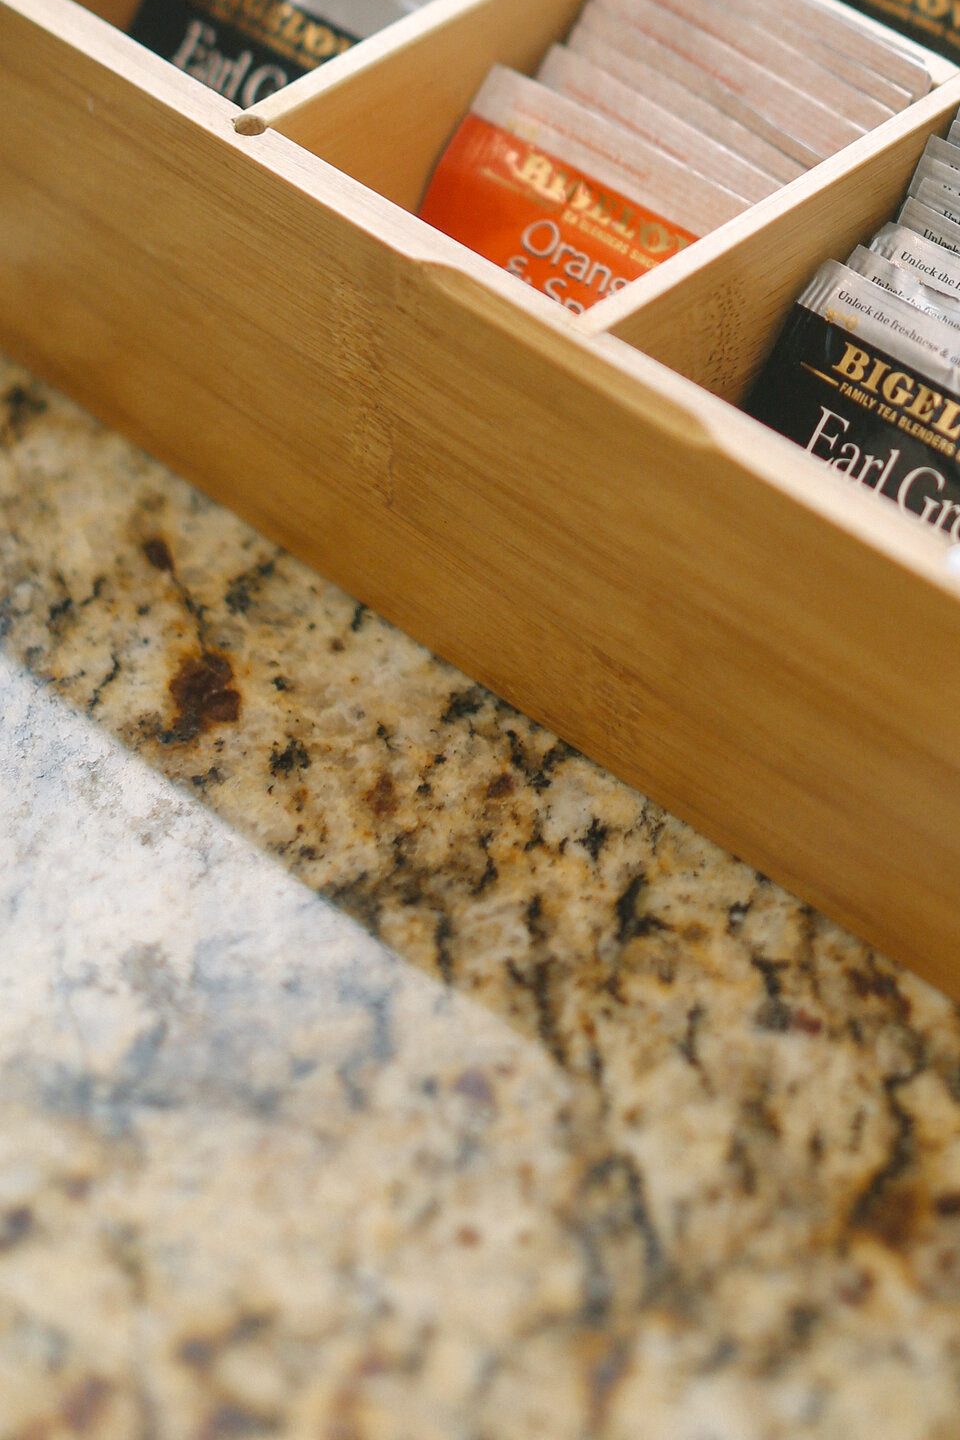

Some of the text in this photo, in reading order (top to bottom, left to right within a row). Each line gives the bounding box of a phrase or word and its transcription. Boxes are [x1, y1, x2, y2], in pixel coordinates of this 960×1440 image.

[901, 251, 938, 278] Unlock
[938, 273, 955, 288] the
[838, 290, 873, 316] Unlock
[873, 310, 890, 325] the
[891, 320, 939, 353] freshness
[940, 347, 951, 357] &
[803, 405, 900, 495] Earl
[840, 382, 877, 409] FAMILY
[877, 403, 897, 424] TEA
[897, 415, 956, 457] BLENDERS
